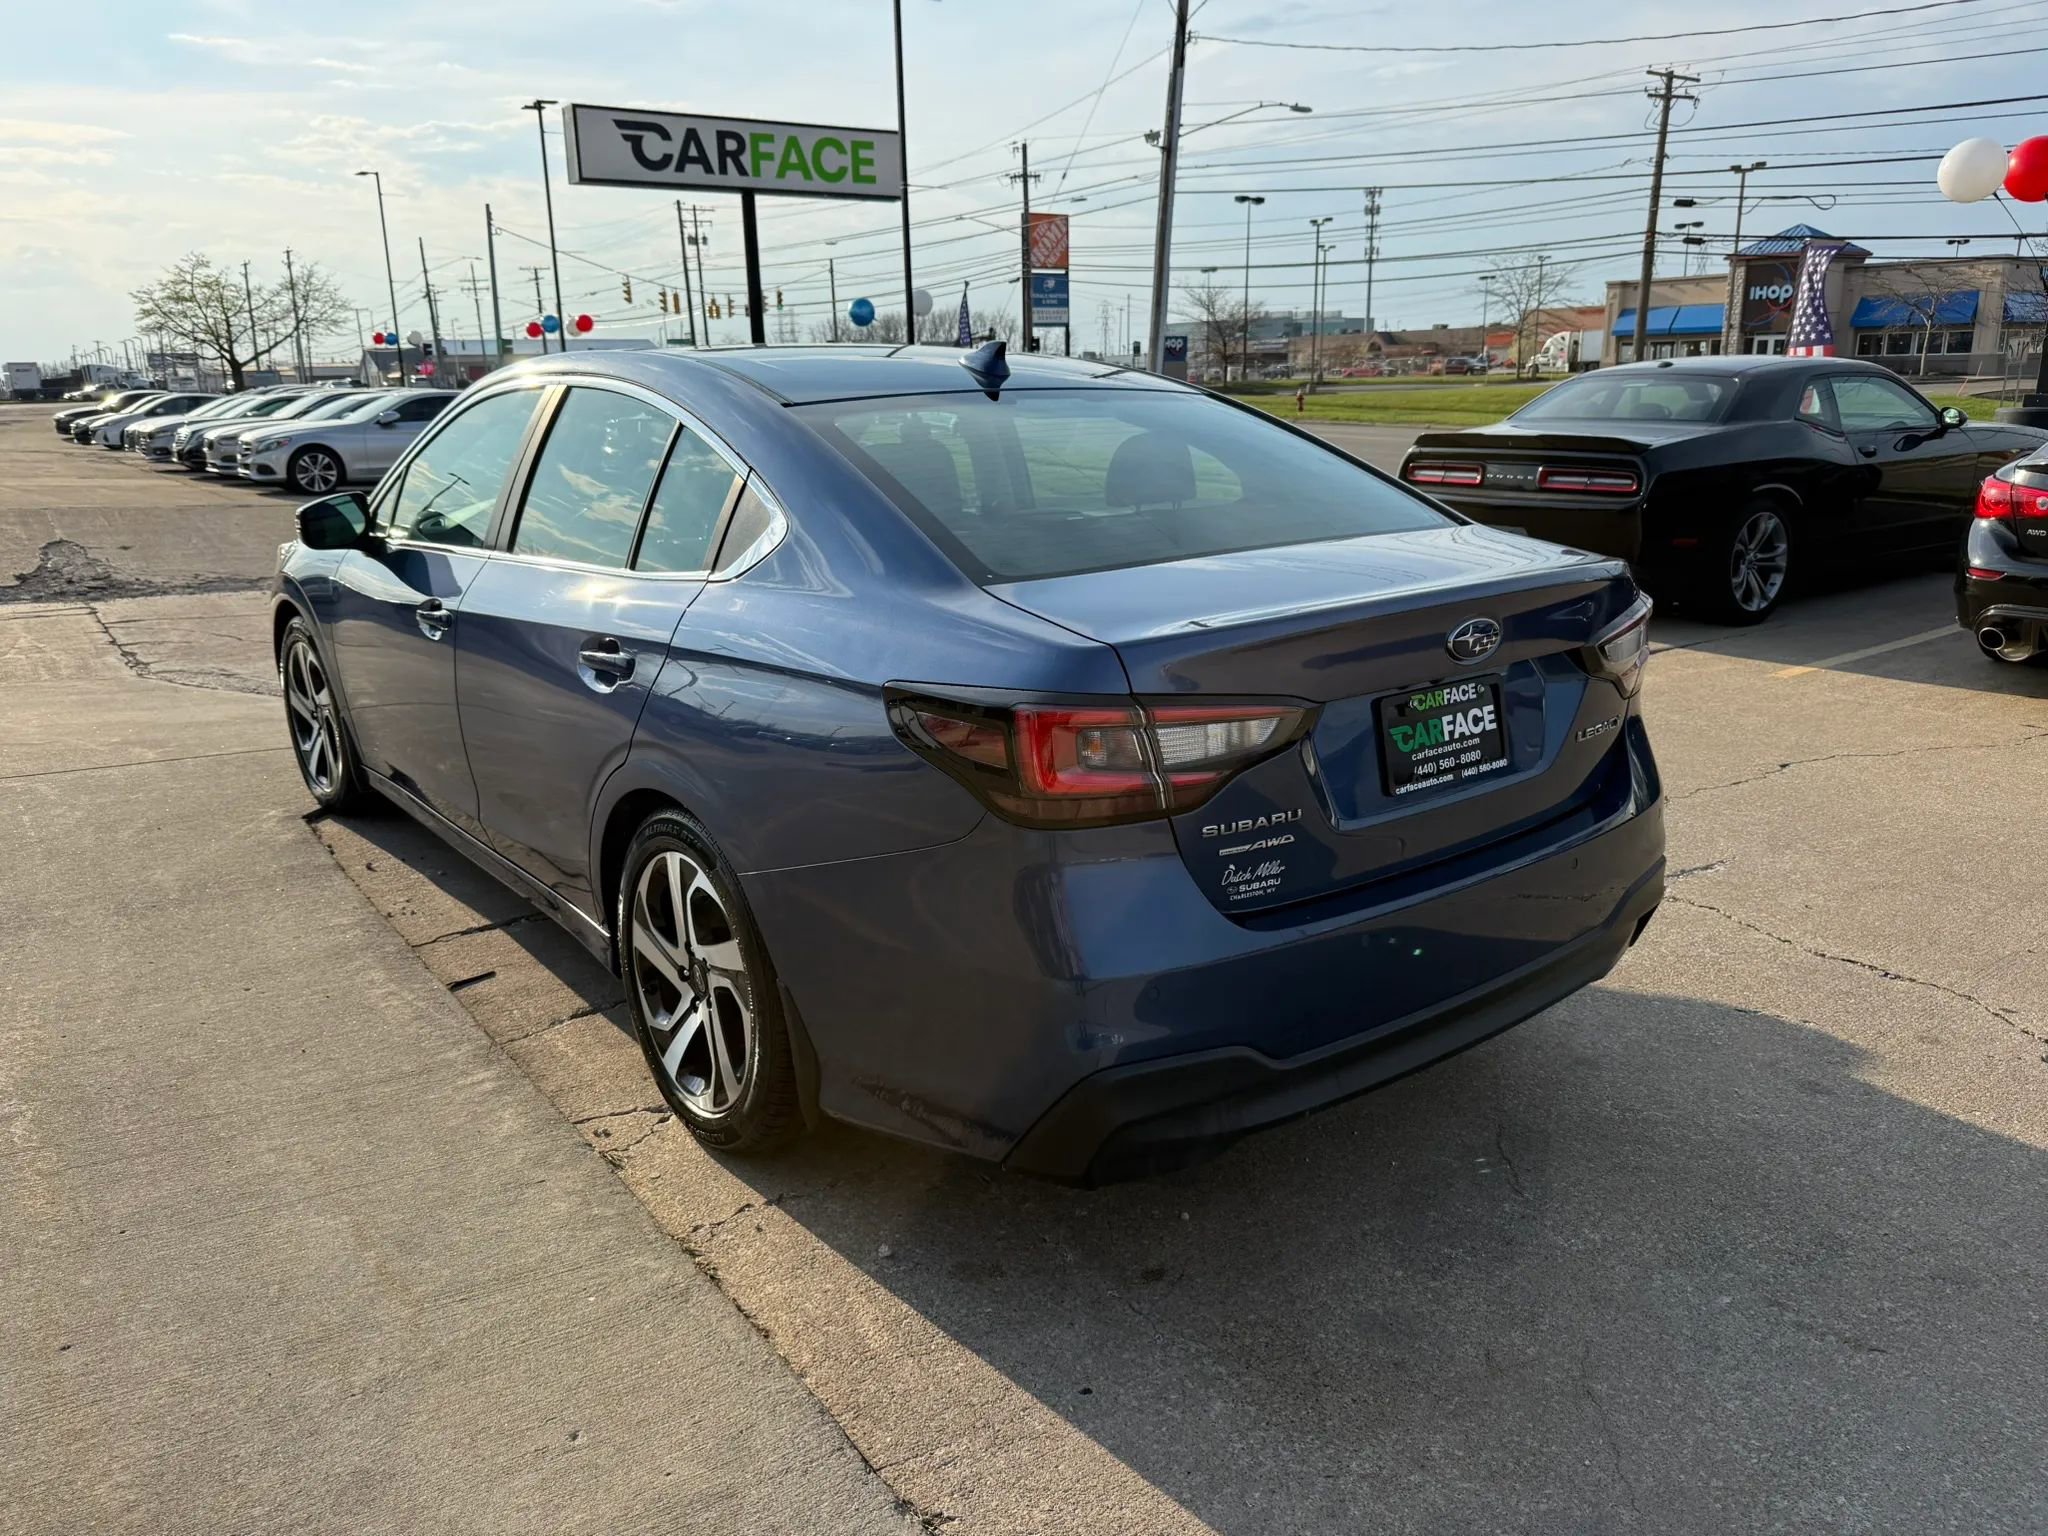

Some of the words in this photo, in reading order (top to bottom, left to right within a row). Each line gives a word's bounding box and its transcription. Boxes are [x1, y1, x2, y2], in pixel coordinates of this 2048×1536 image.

[612, 118, 877, 185] CARFACE
[1031, 217, 1067, 267] HOME
[1749, 284, 1794, 304] IHOP
[1165, 338, 1184, 352] HOP
[2026, 528, 2047, 537] AWD
[1411, 682, 1477, 711] CARFACE
[1389, 704, 1498, 753] CARFACE
[1411, 736, 1481, 761] carfaceauto.com
[1395, 773, 1454, 795] carfaceauto.com
[1478, 758, 1508, 774] 560-8080
[1414, 761, 1437, 776] (440)
[1202, 808, 1303, 837] SUBARU
[1249, 834, 1296, 852] AWD
[1221, 865, 1252, 886] Dutch
[1238, 877, 1281, 893] SUBARU
